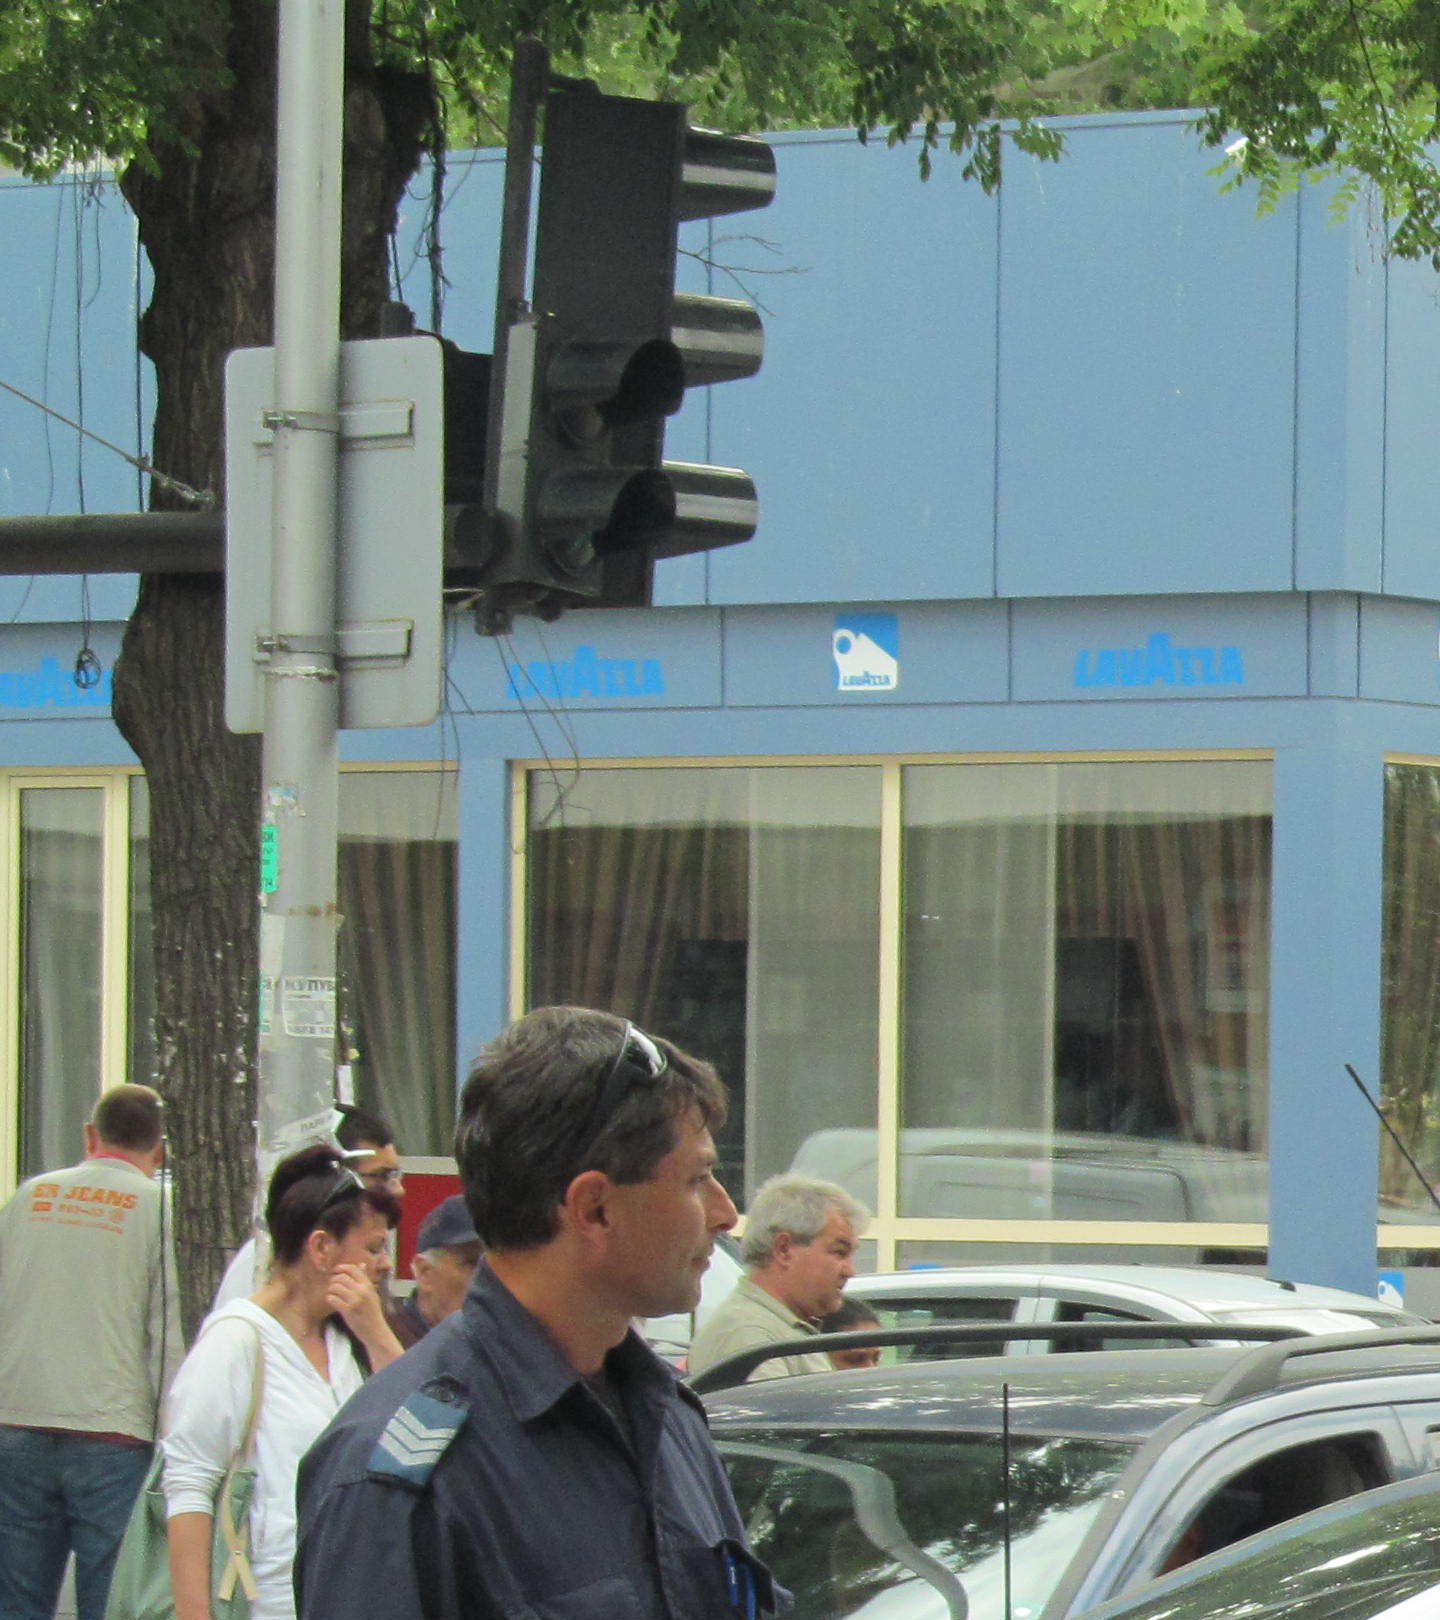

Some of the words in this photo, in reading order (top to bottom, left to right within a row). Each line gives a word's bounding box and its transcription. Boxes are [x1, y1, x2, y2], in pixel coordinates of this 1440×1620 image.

[506, 645, 665, 698] LAVAZZA
[843, 671, 891, 686] LAVAZZA
[1073, 632, 1245, 687] LAVAZZA
